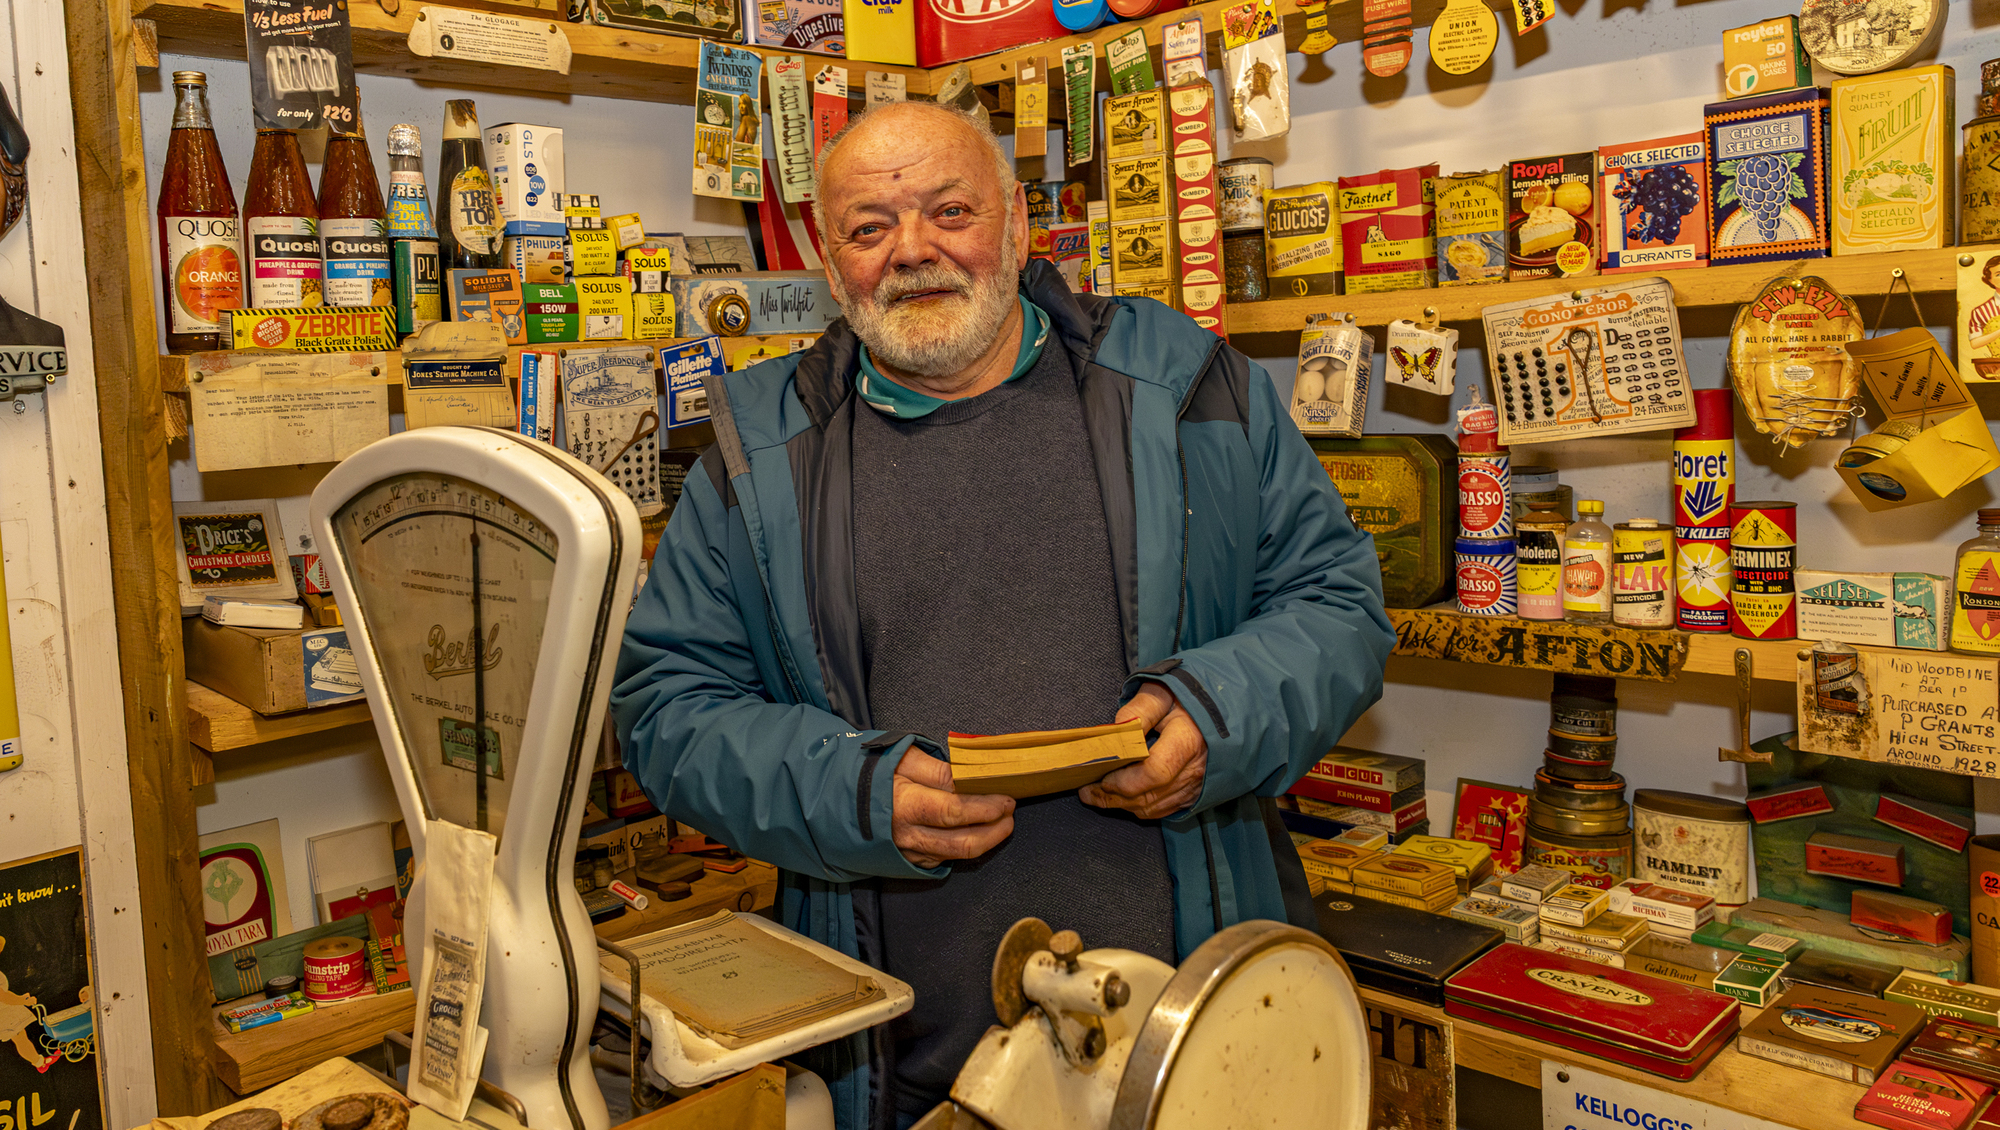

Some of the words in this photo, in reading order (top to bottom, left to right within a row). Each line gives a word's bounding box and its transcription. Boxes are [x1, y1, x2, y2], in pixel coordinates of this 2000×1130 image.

[271, 10, 301, 27] Less
[302, 5, 333, 23] Fuel
[877, 6, 894, 15] milk
[470, 14, 482, 22] The
[485, 16, 520, 27] GLOGAGE
[1449, 20, 1477, 30] UNION
[793, 14, 844, 47] Digestive
[1443, 30, 1465, 38] ELECTRIC
[1734, 23, 1784, 43] raytex
[1168, 39, 1185, 50] Safety
[1185, 36, 1199, 48] Pins
[1766, 42, 1786, 56] 50
[706, 55, 753, 78] TWININGS
[1112, 62, 1132, 75] SAFETY
[1133, 56, 1147, 68] PINS
[1759, 60, 1787, 71] BAKING
[1763, 67, 1788, 77] CASES
[1851, 90, 1892, 102] FINEST
[1175, 104, 1202, 114] CARROLLS
[1849, 100, 1893, 112] QUALITY
[277, 107, 292, 118] for
[293, 109, 314, 121] only
[1859, 87, 1926, 160] FRUIT
[1730, 122, 1790, 140] CHOICE
[522, 129, 534, 159] GLS
[1726, 135, 1799, 153] SELECTED
[1606, 154, 1643, 168] CHOICE
[1647, 145, 1701, 162] SELECTED
[1180, 170, 1207, 179] CARROLLS
[1512, 158, 1564, 179] Royal
[530, 181, 545, 189] 10W
[1512, 177, 1542, 189] Lemon
[1544, 177, 1560, 187] pie
[1561, 173, 1589, 184] filling
[389, 182, 425, 198] FREE
[1224, 187, 1251, 201] Milk
[1512, 188, 1530, 199] mix
[459, 189, 494, 208] TREE
[1342, 189, 1395, 210] Fastnet
[1449, 198, 1488, 209] PATENT
[460, 207, 496, 226] TOP
[526, 210, 542, 219] LED
[543, 211, 561, 221] lamp
[1269, 206, 1326, 232] GLUCOSE
[1438, 208, 1499, 223] CORNFLOUR
[1861, 207, 1916, 219] SPECIALLY
[178, 218, 240, 241] QUOSH
[1860, 217, 1916, 229] SELECTED
[526, 239, 562, 250] PHILIPS
[575, 233, 610, 243] SOLUS
[1184, 235, 1211, 244] CARROLLS
[260, 237, 320, 254] Quosh
[331, 240, 389, 255] Quosh
[1565, 243, 1581, 251] NEW
[1377, 250, 1402, 258] SAGO
[1621, 249, 1692, 265] CURRANTS
[634, 258, 667, 269] SOLUS
[189, 271, 240, 283] ORANGE
[286, 268, 305, 276] DRINK
[1512, 269, 1530, 277] TWIN
[1530, 268, 1549, 276] PACK
[465, 275, 511, 287] SOLIDEX
[539, 288, 564, 298] BELL
[581, 283, 622, 294] SOLUS
[539, 304, 567, 314] 150W
[759, 287, 779, 322] Miss
[776, 283, 815, 324] Twilfit
[1188, 299, 1215, 308] CARROLLS
[1752, 285, 1850, 324] SEW-EZY
[642, 316, 673, 325] SOLUS
[1777, 313, 1819, 321] STAINLESS
[256, 322, 283, 336] BIGGER
[257, 319, 275, 332] NEW
[294, 313, 382, 337] ZEBRITE
[1785, 321, 1813, 329] LACER
[261, 329, 284, 342] VALUE
[1497, 331, 1514, 339] SELF
[1515, 328, 1550, 338] ADJUSTING
[1744, 335, 1758, 344] ALL
[1788, 334, 1809, 343] HARE
[1820, 333, 1852, 343] RABBIT
[295, 336, 322, 347] Black
[324, 336, 351, 347] Grate
[353, 335, 382, 347] Polish
[1499, 338, 1529, 349] Secure
[1529, 336, 1544, 344] and
[667, 355, 713, 377] Gillette
[671, 368, 711, 387] Platinum
[1912, 376, 1929, 398] Quality
[1931, 381, 1948, 403] SNUFF
[1302, 406, 1337, 419] Kinsale
[1634, 406, 1648, 416] 24
[1648, 403, 1687, 415] FASTENERS
[1510, 422, 1522, 431] 24
[1522, 419, 1557, 430] BUTTONS
[1458, 487, 1501, 506] BRASSO
[194, 524, 255, 555] PRICE'S
[188, 554, 234, 568] CHRISTMAS
[235, 552, 271, 566] CANDLES
[1623, 553, 1645, 561] NEW
[1458, 575, 1497, 593] BRASSO
[1613, 565, 1668, 592] FLAK
[1615, 593, 1658, 602] INSECTICIDE
[1813, 581, 1872, 601] SELFSET
[1735, 601, 1764, 611] GARDEN
[1767, 602, 1784, 611] AND
[1805, 598, 1881, 608] MOUSETRAP
[1680, 613, 1725, 621] KNOCKDOWN
[1738, 609, 1780, 618] HOUSEHOLD
[423, 622, 503, 674] Berkel
[1396, 620, 1436, 651] Ask
[1444, 626, 1480, 658] for
[1487, 626, 1673, 677] AFTON
[1917, 661, 1993, 682] WOODBINE
[1920, 675, 1939, 686] AT
[410, 693, 424, 703] THE
[425, 696, 453, 711] BERKEL
[454, 704, 474, 716] AUTO
[484, 711, 500, 723] ALE
[1881, 694, 1967, 717] PURCHASED
[1576, 719, 1593, 728] Cut
[1901, 713, 1913, 730] P
[1920, 715, 1995, 738] GRANTS
[1936, 733, 1997, 755] STREET
[1886, 747, 1942, 765] AROUND
[1954, 756, 1997, 774] 1928
[1347, 769, 1382, 784] CUT
[1336, 789, 1354, 800] JOHN
[1354, 793, 1381, 805] PLAYER
[1646, 855, 1723, 880] HAMLET
[1570, 876, 1605, 887] CAP
[1660, 873, 1678, 882] MILD
[1679, 876, 1706, 888] CIGARS
[1632, 906, 1668, 919] RICHMAN
[236, 921, 265, 943] TARA
[366, 939, 375, 956] CAKE
[303, 961, 351, 976] Gumstrip
[371, 956, 388, 988] CANDLES
[1644, 961, 1668, 976] Gold
[1669, 967, 1698, 983] Bond
[324, 974, 342, 982] TAPE
[1537, 969, 1622, 998] CRAVEN
[1624, 989, 1649, 1004] "A"
[1724, 987, 1750, 998] MAJOR
[432, 1001, 461, 1017] GROCERS
[1876, 1091, 1952, 1117] WINTERMANS
[1898, 1093, 1932, 1108] HENRI
[1574, 1092, 1694, 1130] KELLOGG'S
[1892, 1102, 1925, 1116] CLUB
